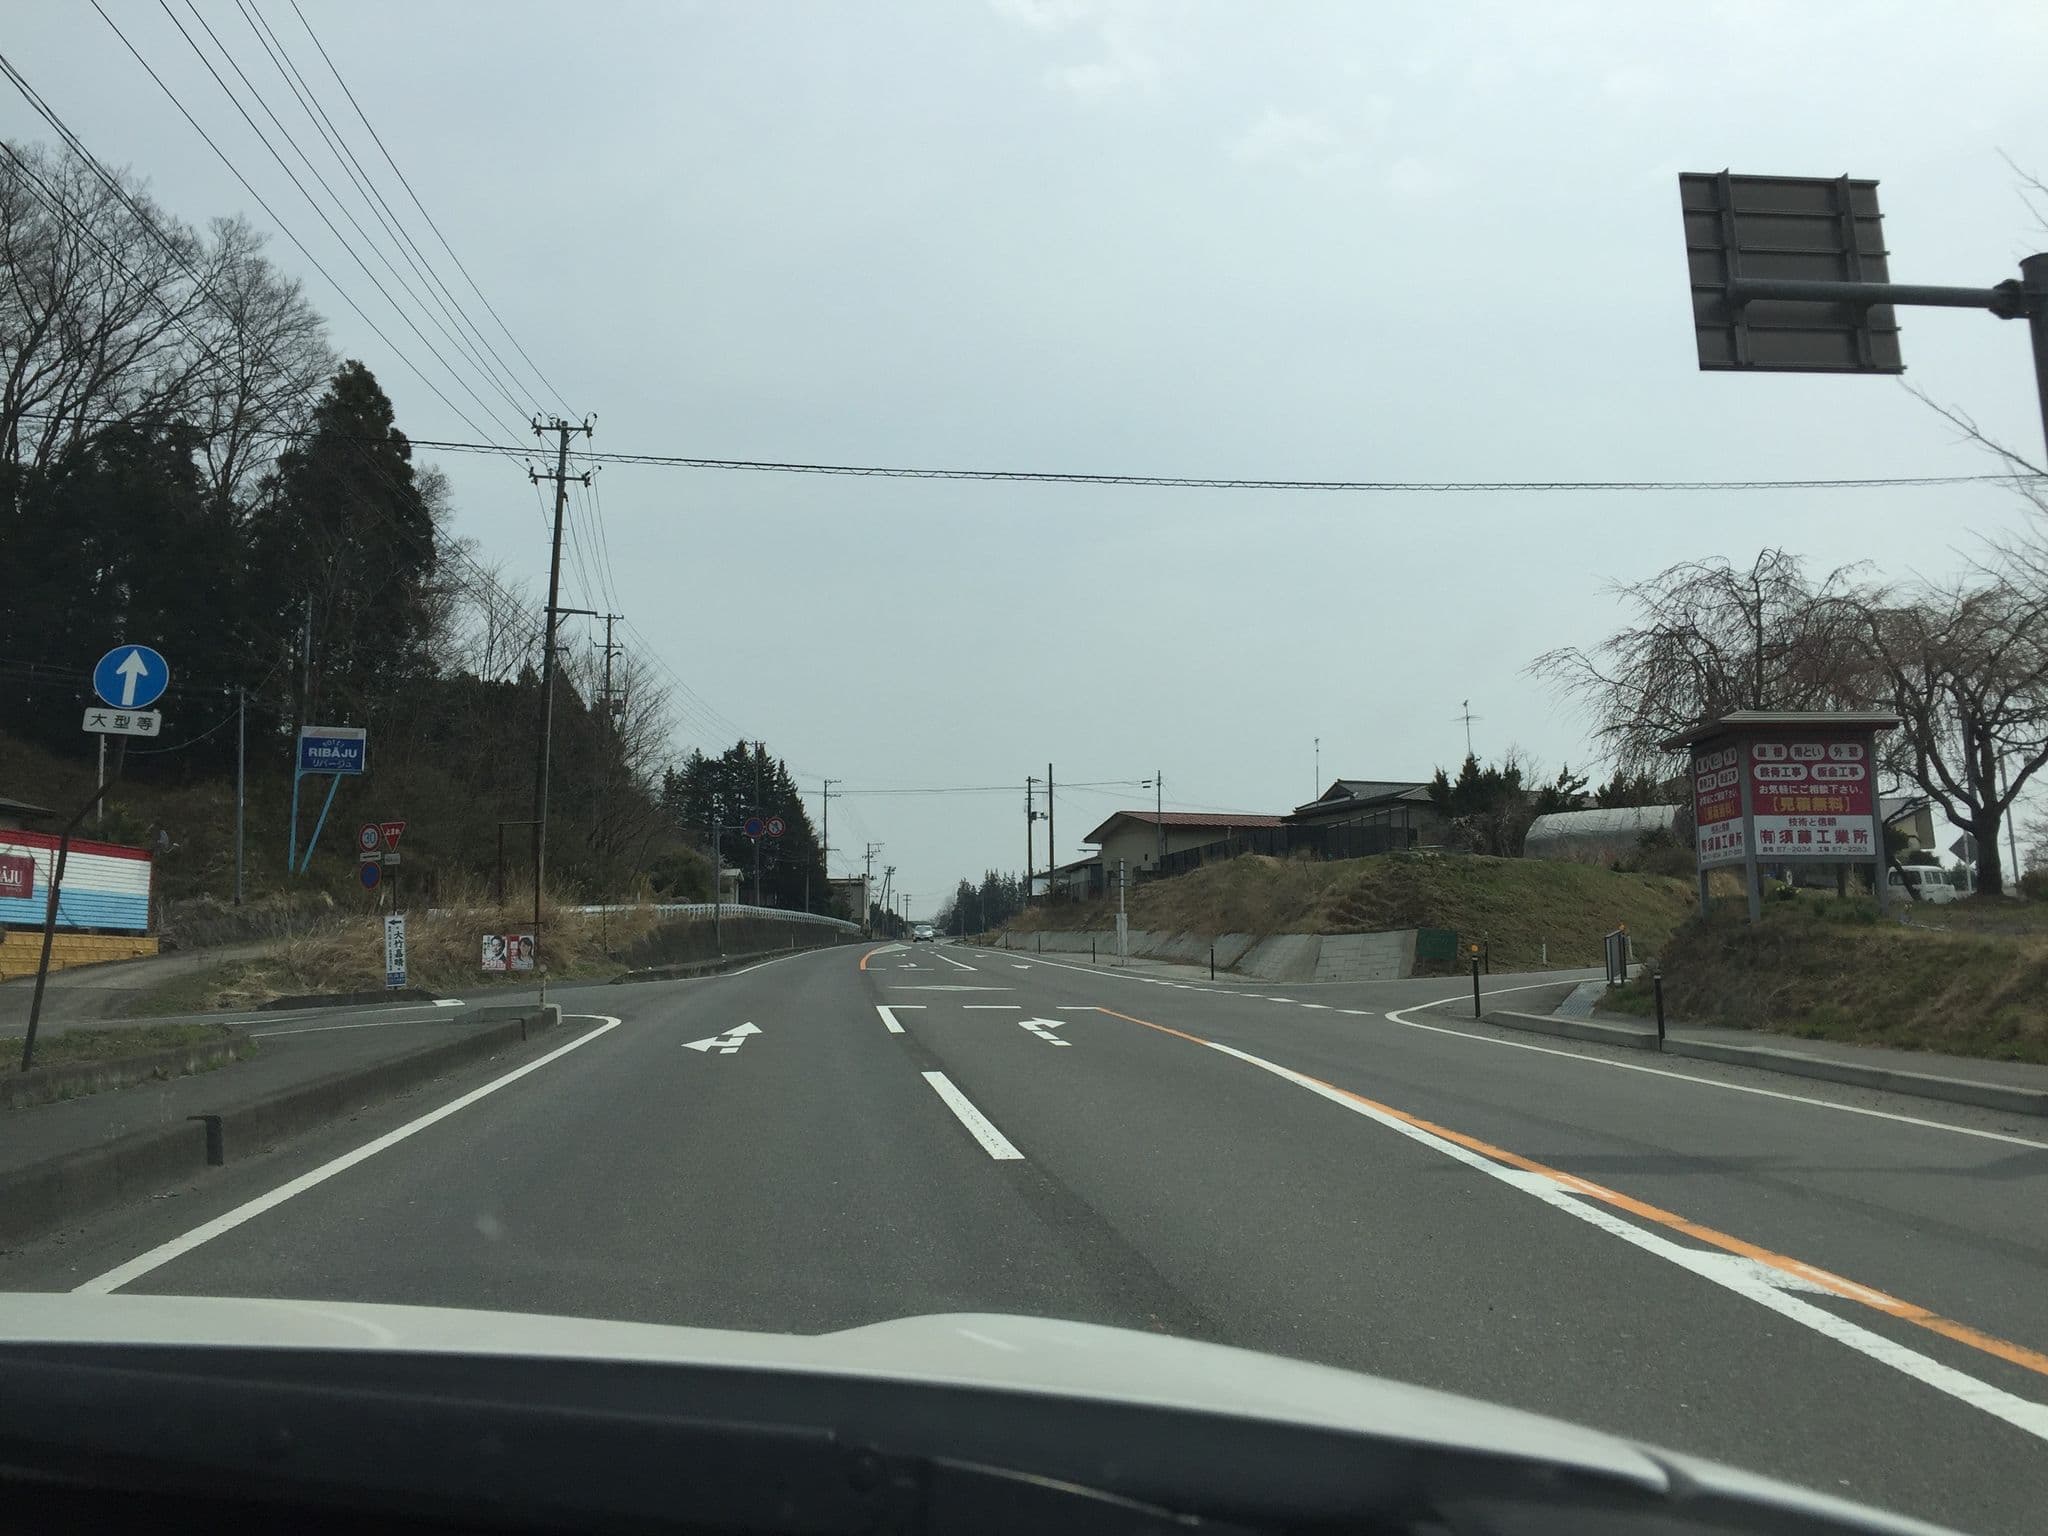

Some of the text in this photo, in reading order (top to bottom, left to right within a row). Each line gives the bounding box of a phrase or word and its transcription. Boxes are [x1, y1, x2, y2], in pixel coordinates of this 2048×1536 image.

[90, 713, 153, 730] 大型等
[1788, 817, 1837, 827] 技術と信頼
[364, 832, 377, 844] 30
